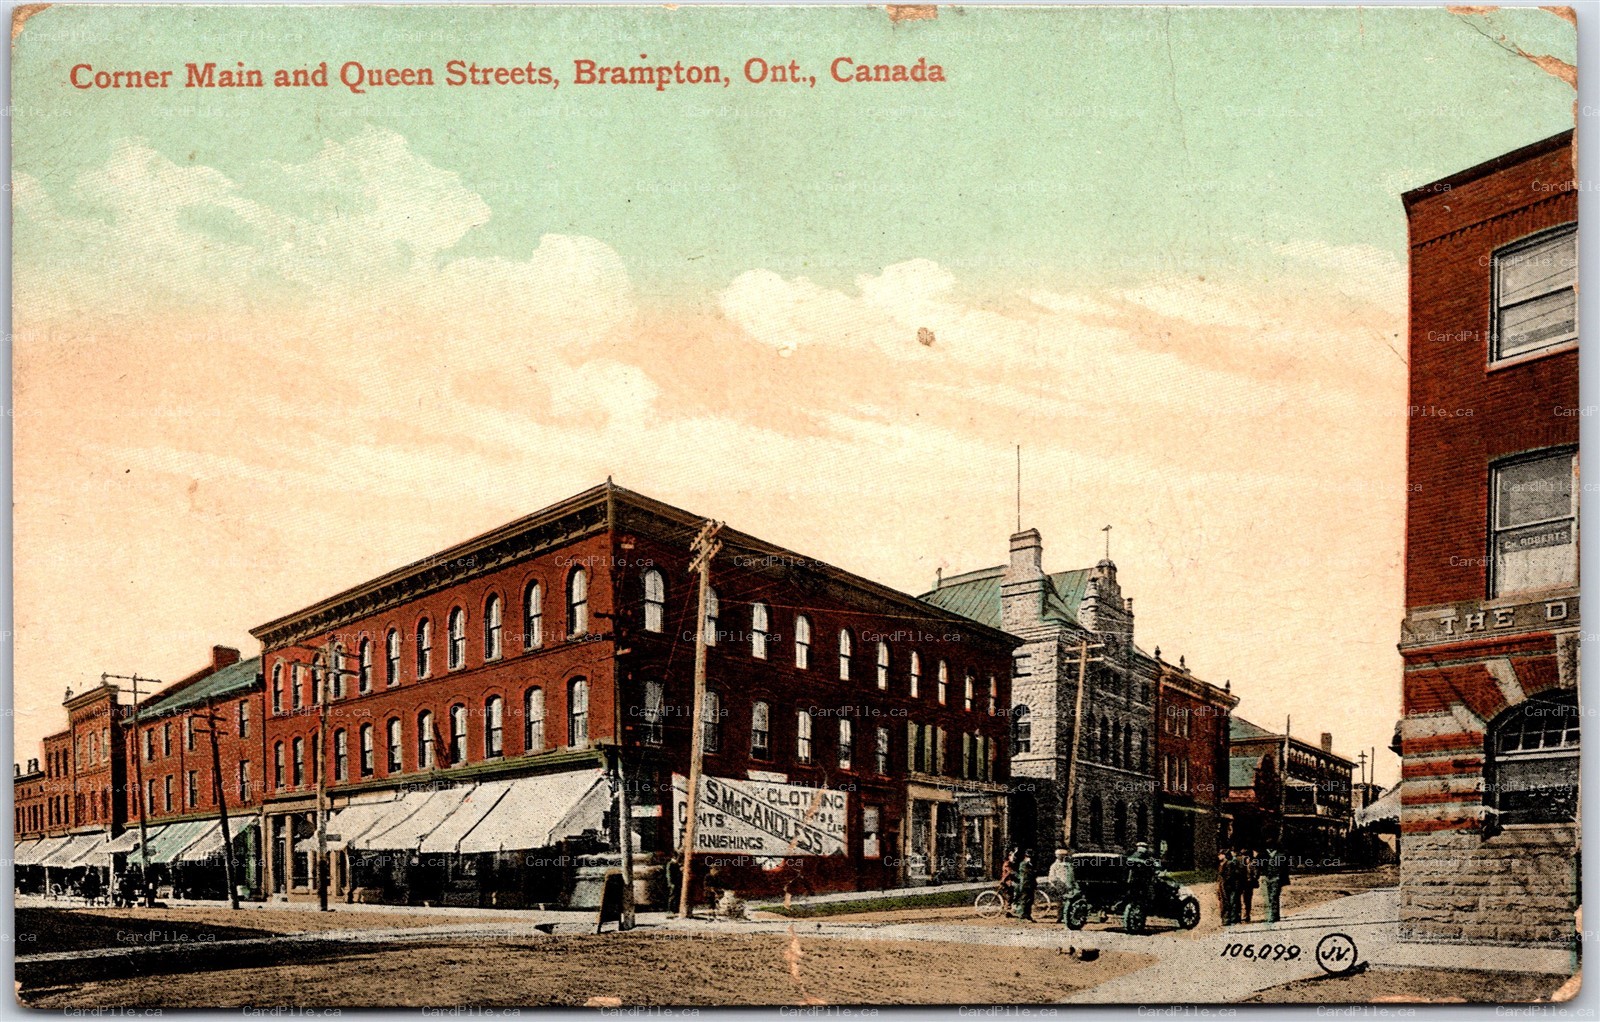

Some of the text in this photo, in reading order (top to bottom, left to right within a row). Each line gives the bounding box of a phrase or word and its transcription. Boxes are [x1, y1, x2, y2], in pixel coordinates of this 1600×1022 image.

[1520, 531, 1569, 547] ROBERTS
[1440, 601, 1568, 635] THE D
